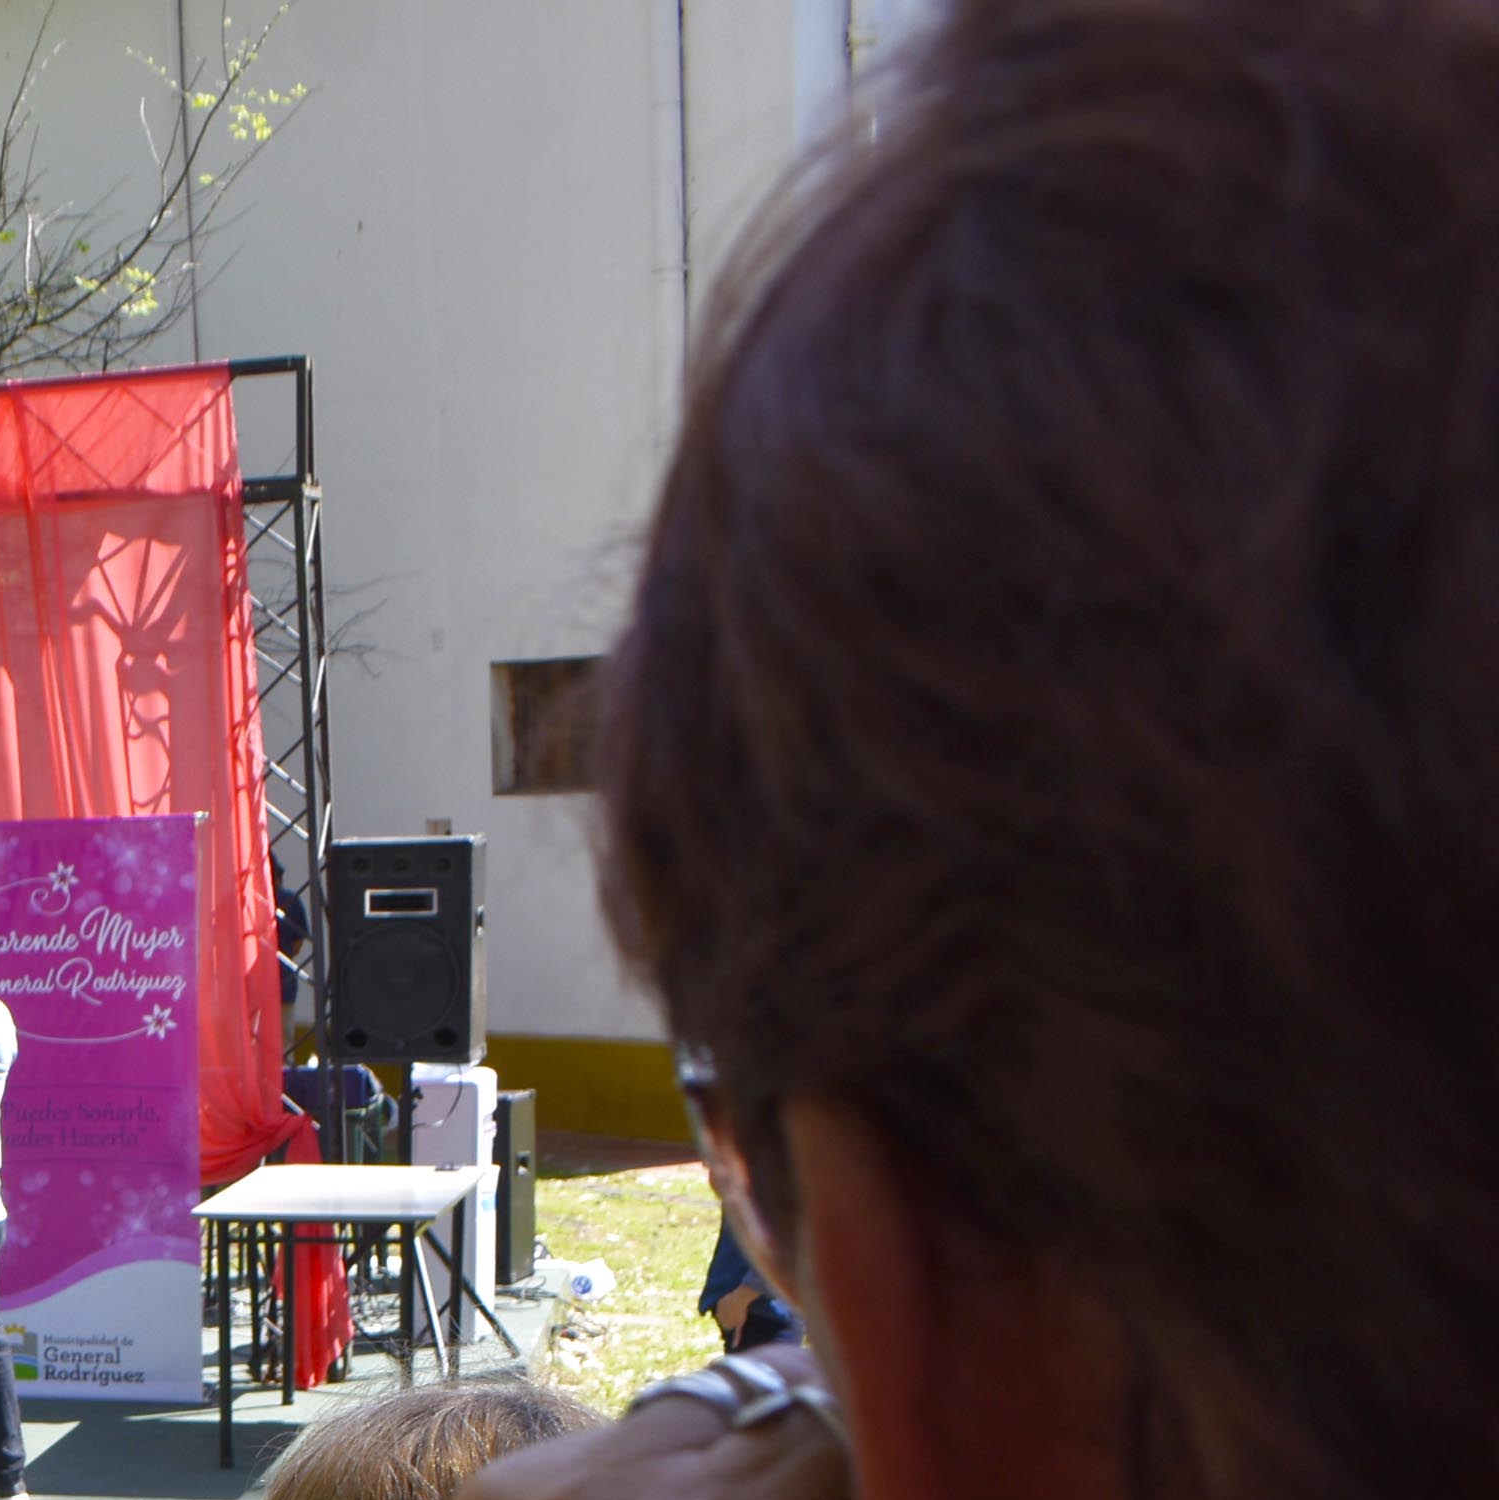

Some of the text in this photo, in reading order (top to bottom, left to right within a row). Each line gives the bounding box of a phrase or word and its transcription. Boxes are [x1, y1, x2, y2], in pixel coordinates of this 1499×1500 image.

[80, 905, 185, 963] Mujer
[3, 1097, 70, 1122] Puedes
[4, 1121, 54, 1146] uedes
[43, 1334, 134, 1347] Municipalidad de
[43, 1346, 121, 1364] General
